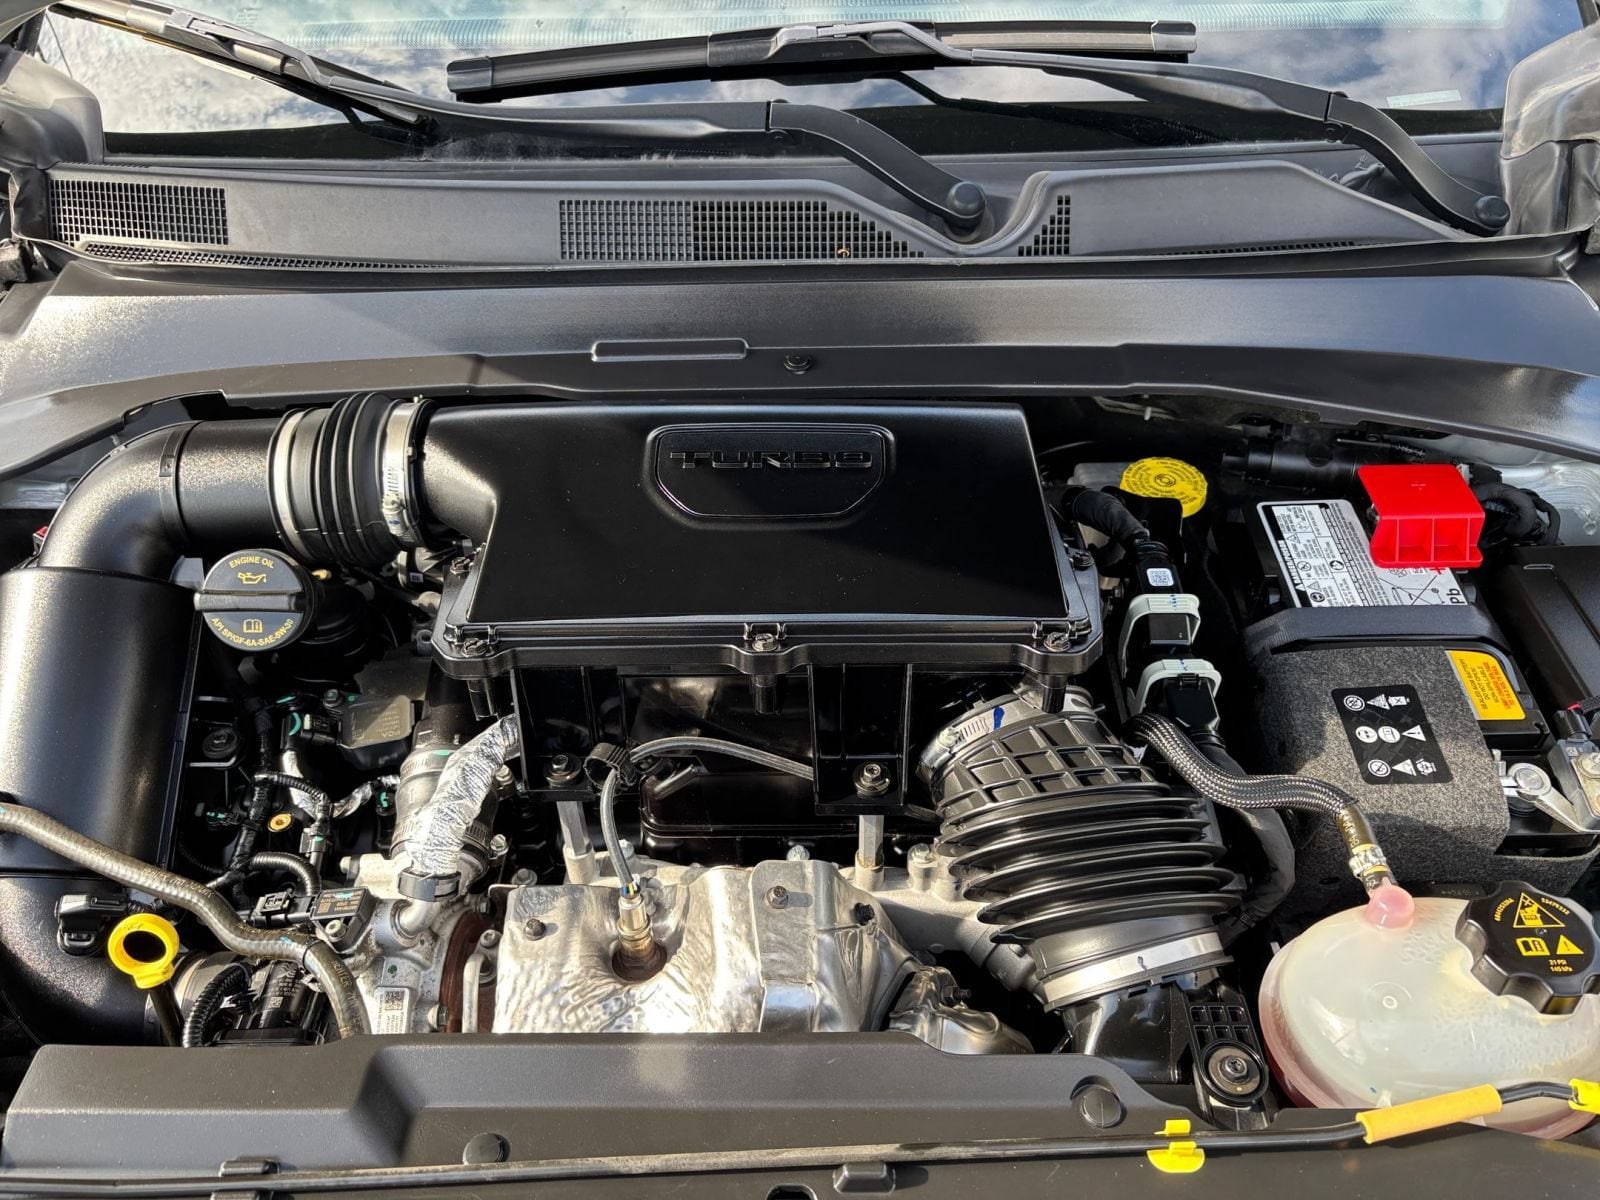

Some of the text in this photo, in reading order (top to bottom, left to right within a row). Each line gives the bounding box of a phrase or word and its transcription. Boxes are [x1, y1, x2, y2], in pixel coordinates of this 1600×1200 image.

[669, 450, 873, 469] TURBO
[229, 556, 274, 569] ENGINE OIL
[1445, 588, 1466, 604] Pb
[211, 617, 223, 631] API
